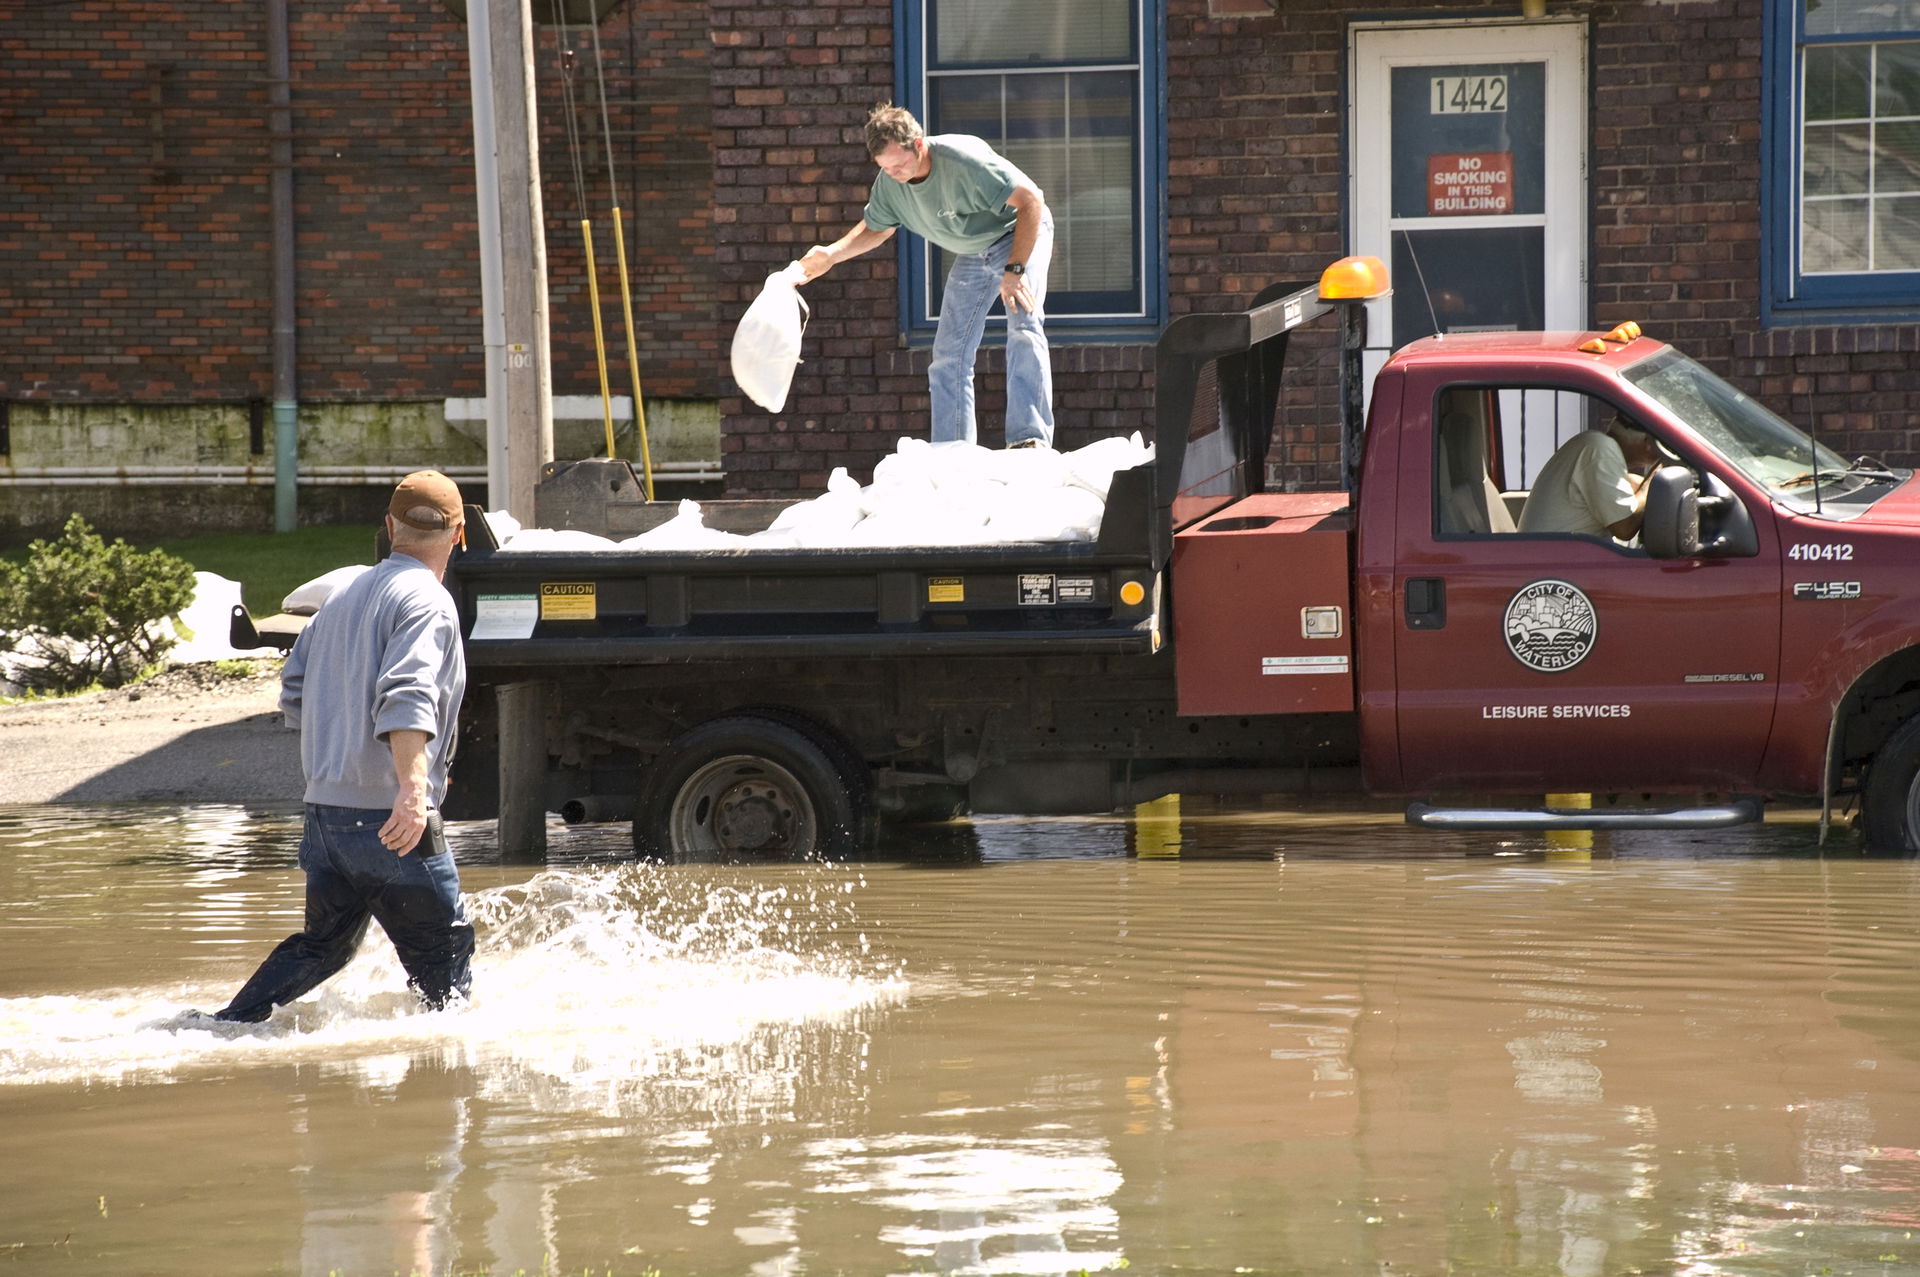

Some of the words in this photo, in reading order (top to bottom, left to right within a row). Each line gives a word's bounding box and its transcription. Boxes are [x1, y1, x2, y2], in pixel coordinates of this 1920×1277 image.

[1436, 77, 1506, 112] 1442
[1458, 157, 1482, 170] NO
[1434, 171, 1507, 185] SMOKING
[1447, 186, 1461, 196] IN
[1463, 184, 1493, 196] THIS
[1434, 196, 1507, 210] BUILDING
[1788, 544, 1854, 561] 410412
[543, 585, 593, 594] CAUTION
[1527, 584, 1554, 599] CITY
[1556, 585, 1573, 598] OF
[1515, 640, 1586, 667] WATERLOO
[1714, 673, 1750, 682] DIESEL
[1750, 673, 1764, 681] V8
[1483, 706, 1548, 719] LEISURE
[1552, 705, 1631, 718] SERVICES
